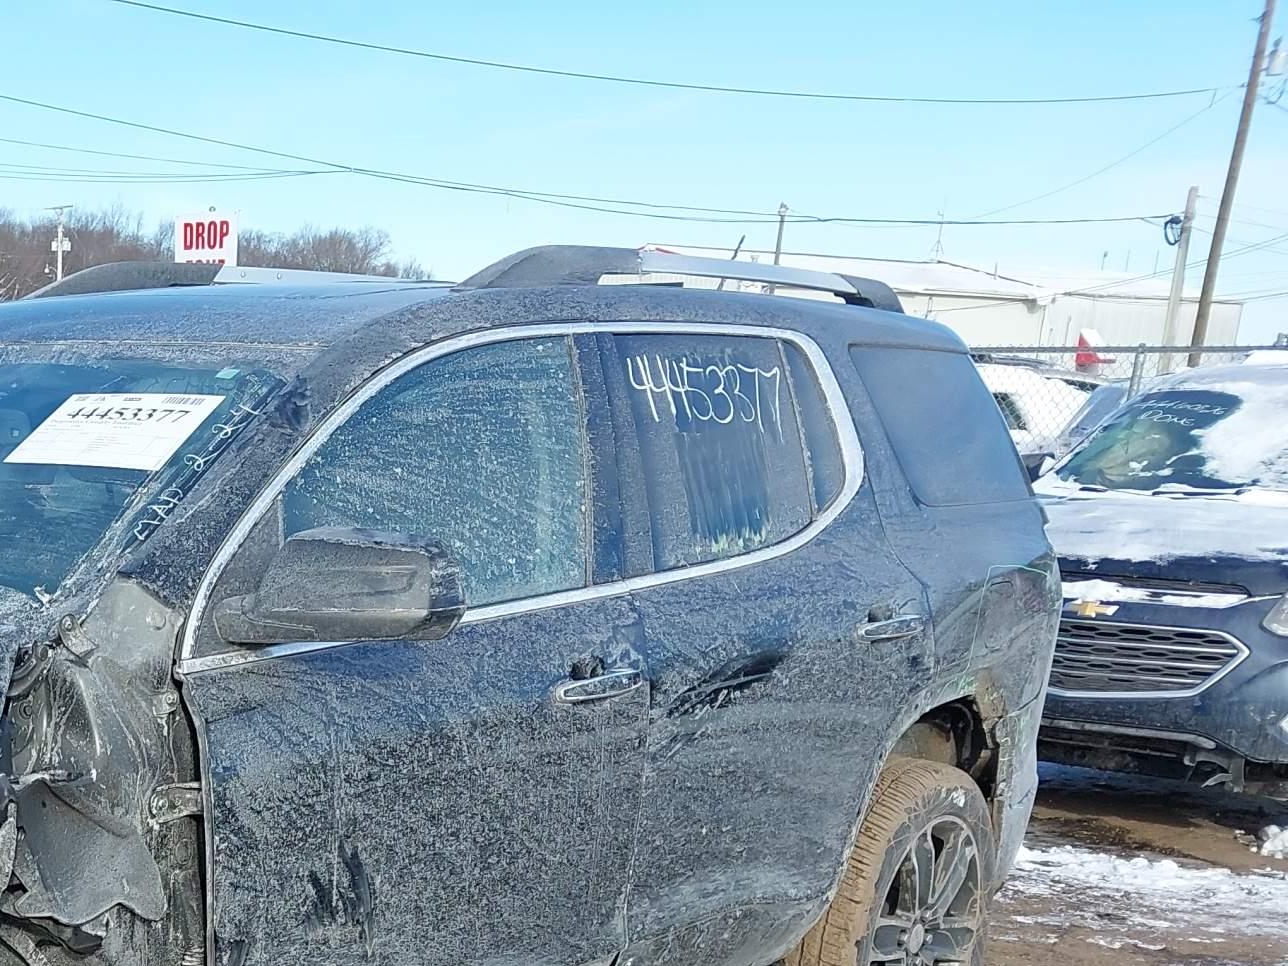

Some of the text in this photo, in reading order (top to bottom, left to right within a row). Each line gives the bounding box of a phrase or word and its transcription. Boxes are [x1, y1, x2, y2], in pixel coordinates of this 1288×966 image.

[183, 220, 230, 251] DROP
[66, 405, 193, 424] 44453377
[625, 353, 787, 445] 44453377
